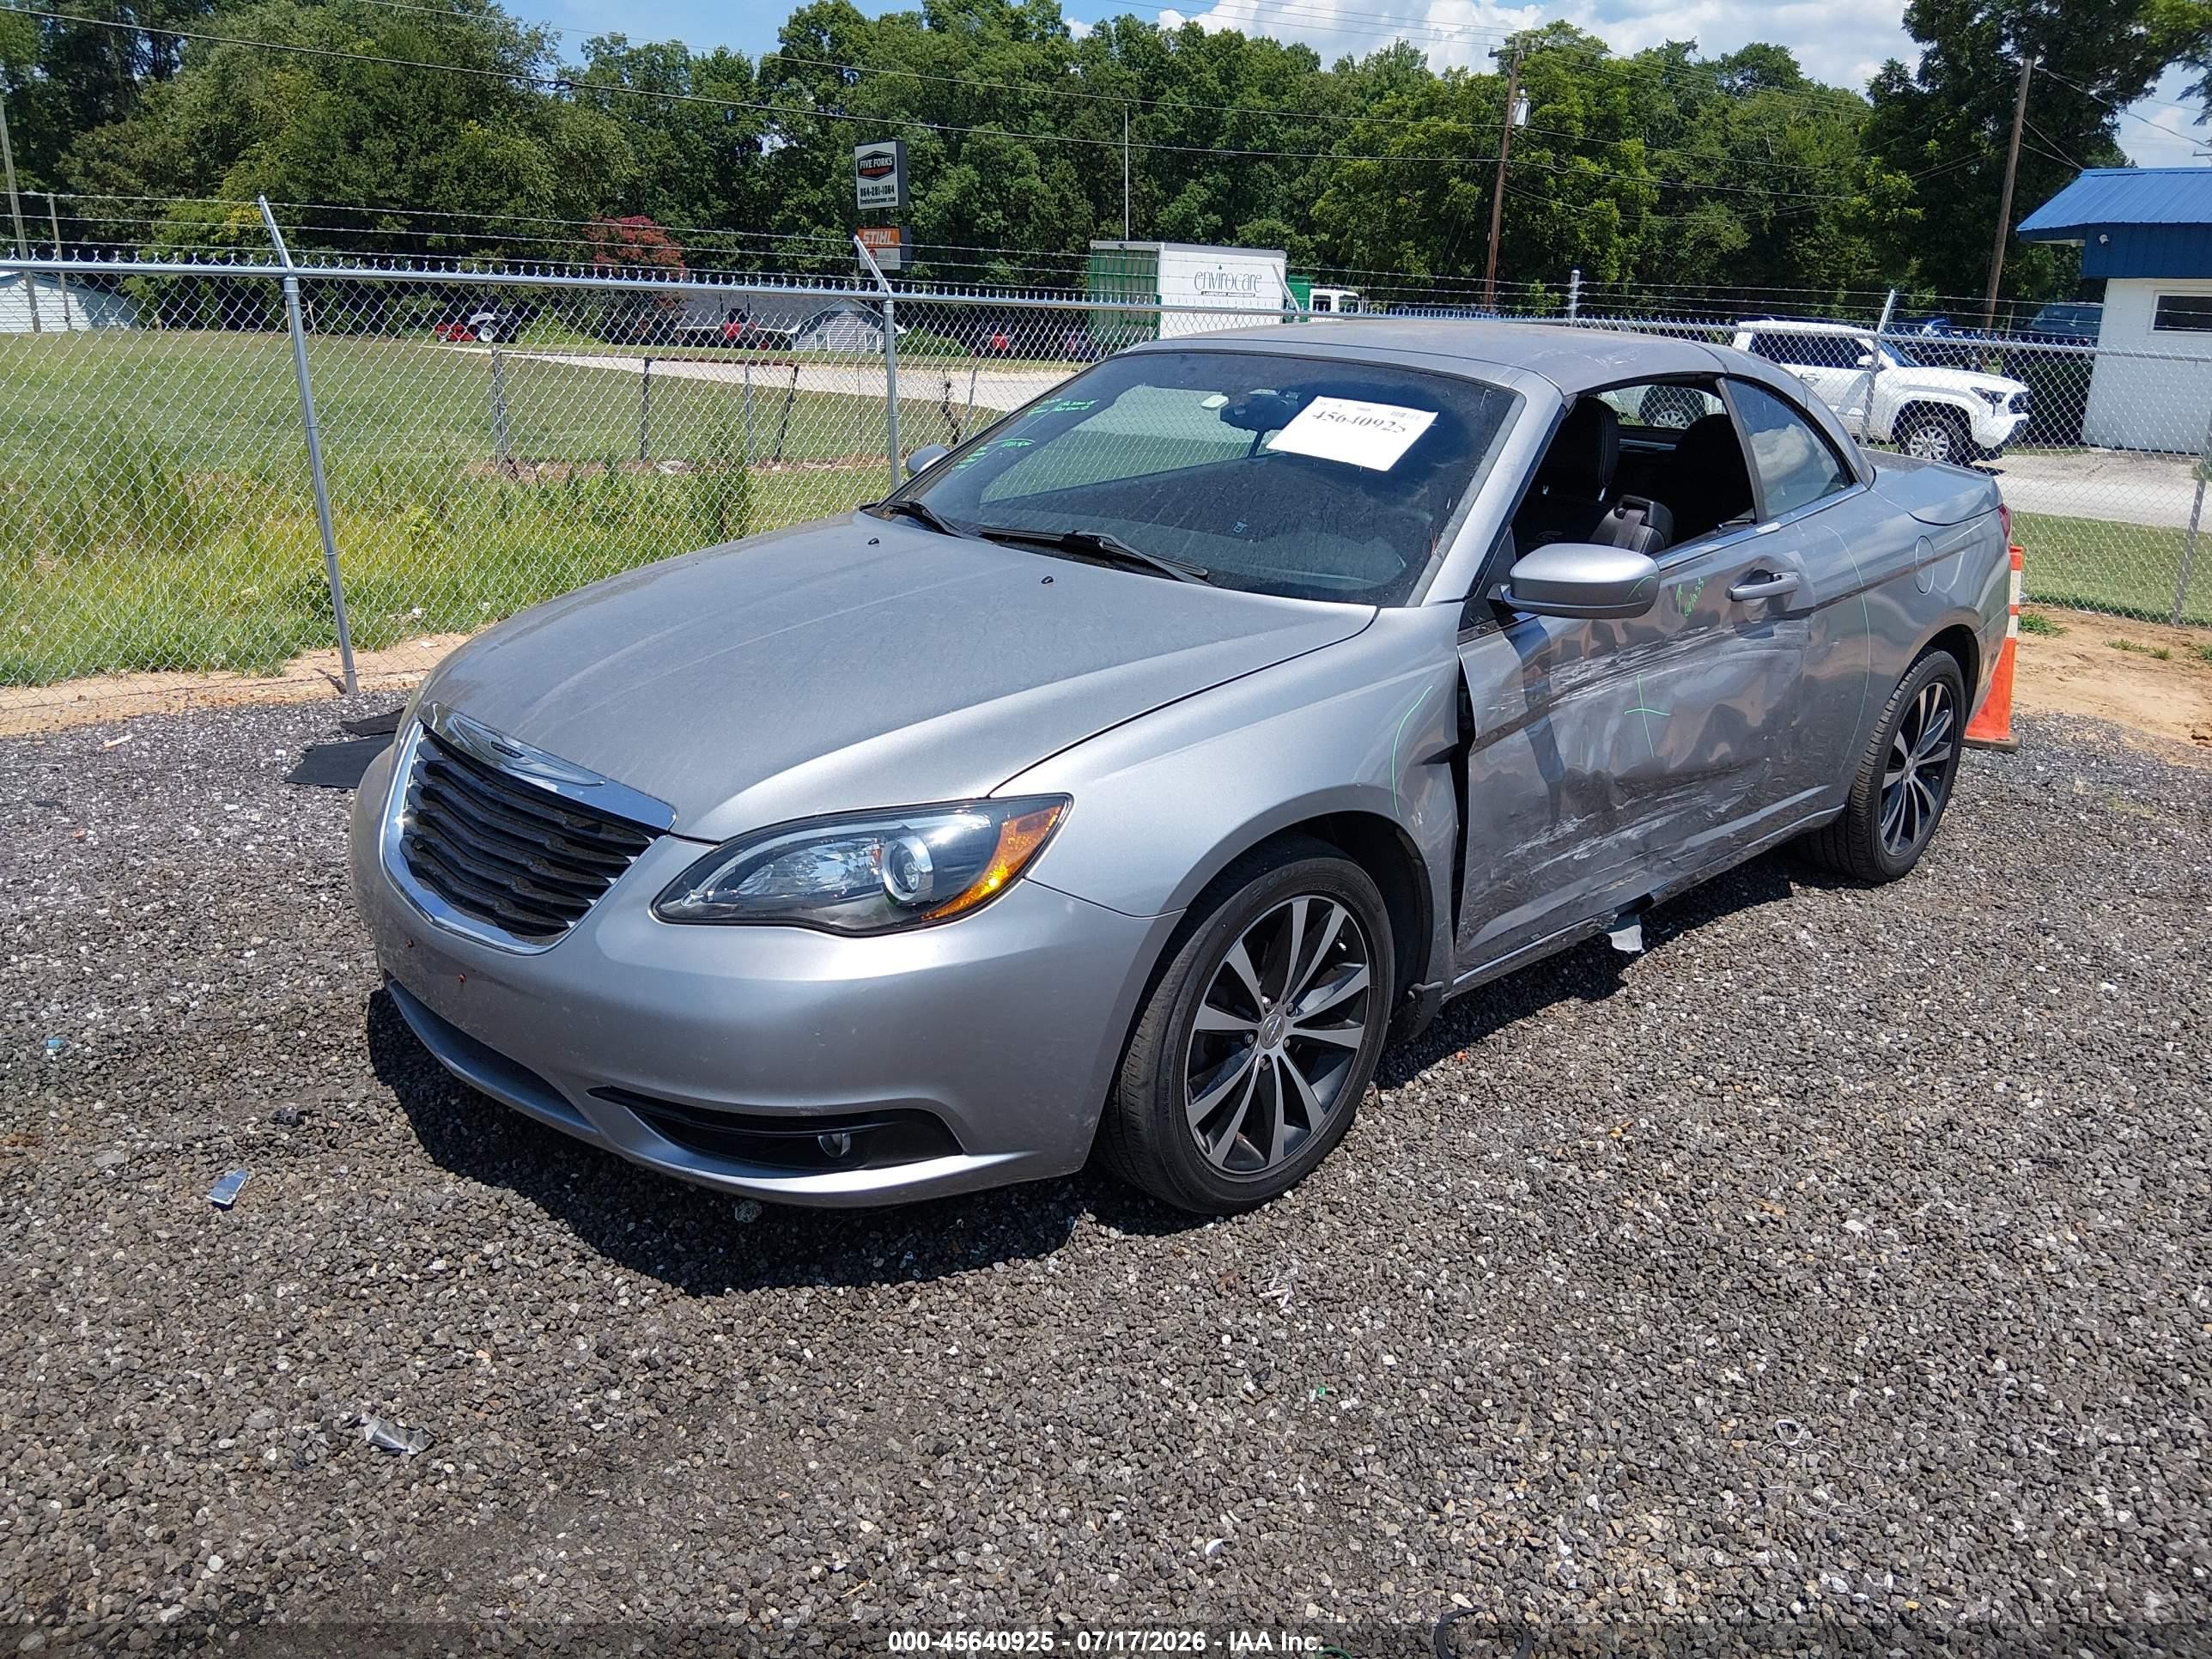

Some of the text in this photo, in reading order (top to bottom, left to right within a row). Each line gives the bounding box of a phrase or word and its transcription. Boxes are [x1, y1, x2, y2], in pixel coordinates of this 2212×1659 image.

[860, 156, 893, 169] FIVE FORKS
[862, 230, 895, 245] STIHL
[1194, 271, 1262, 293] envirocare
[1312, 410, 1407, 434] 45640925
